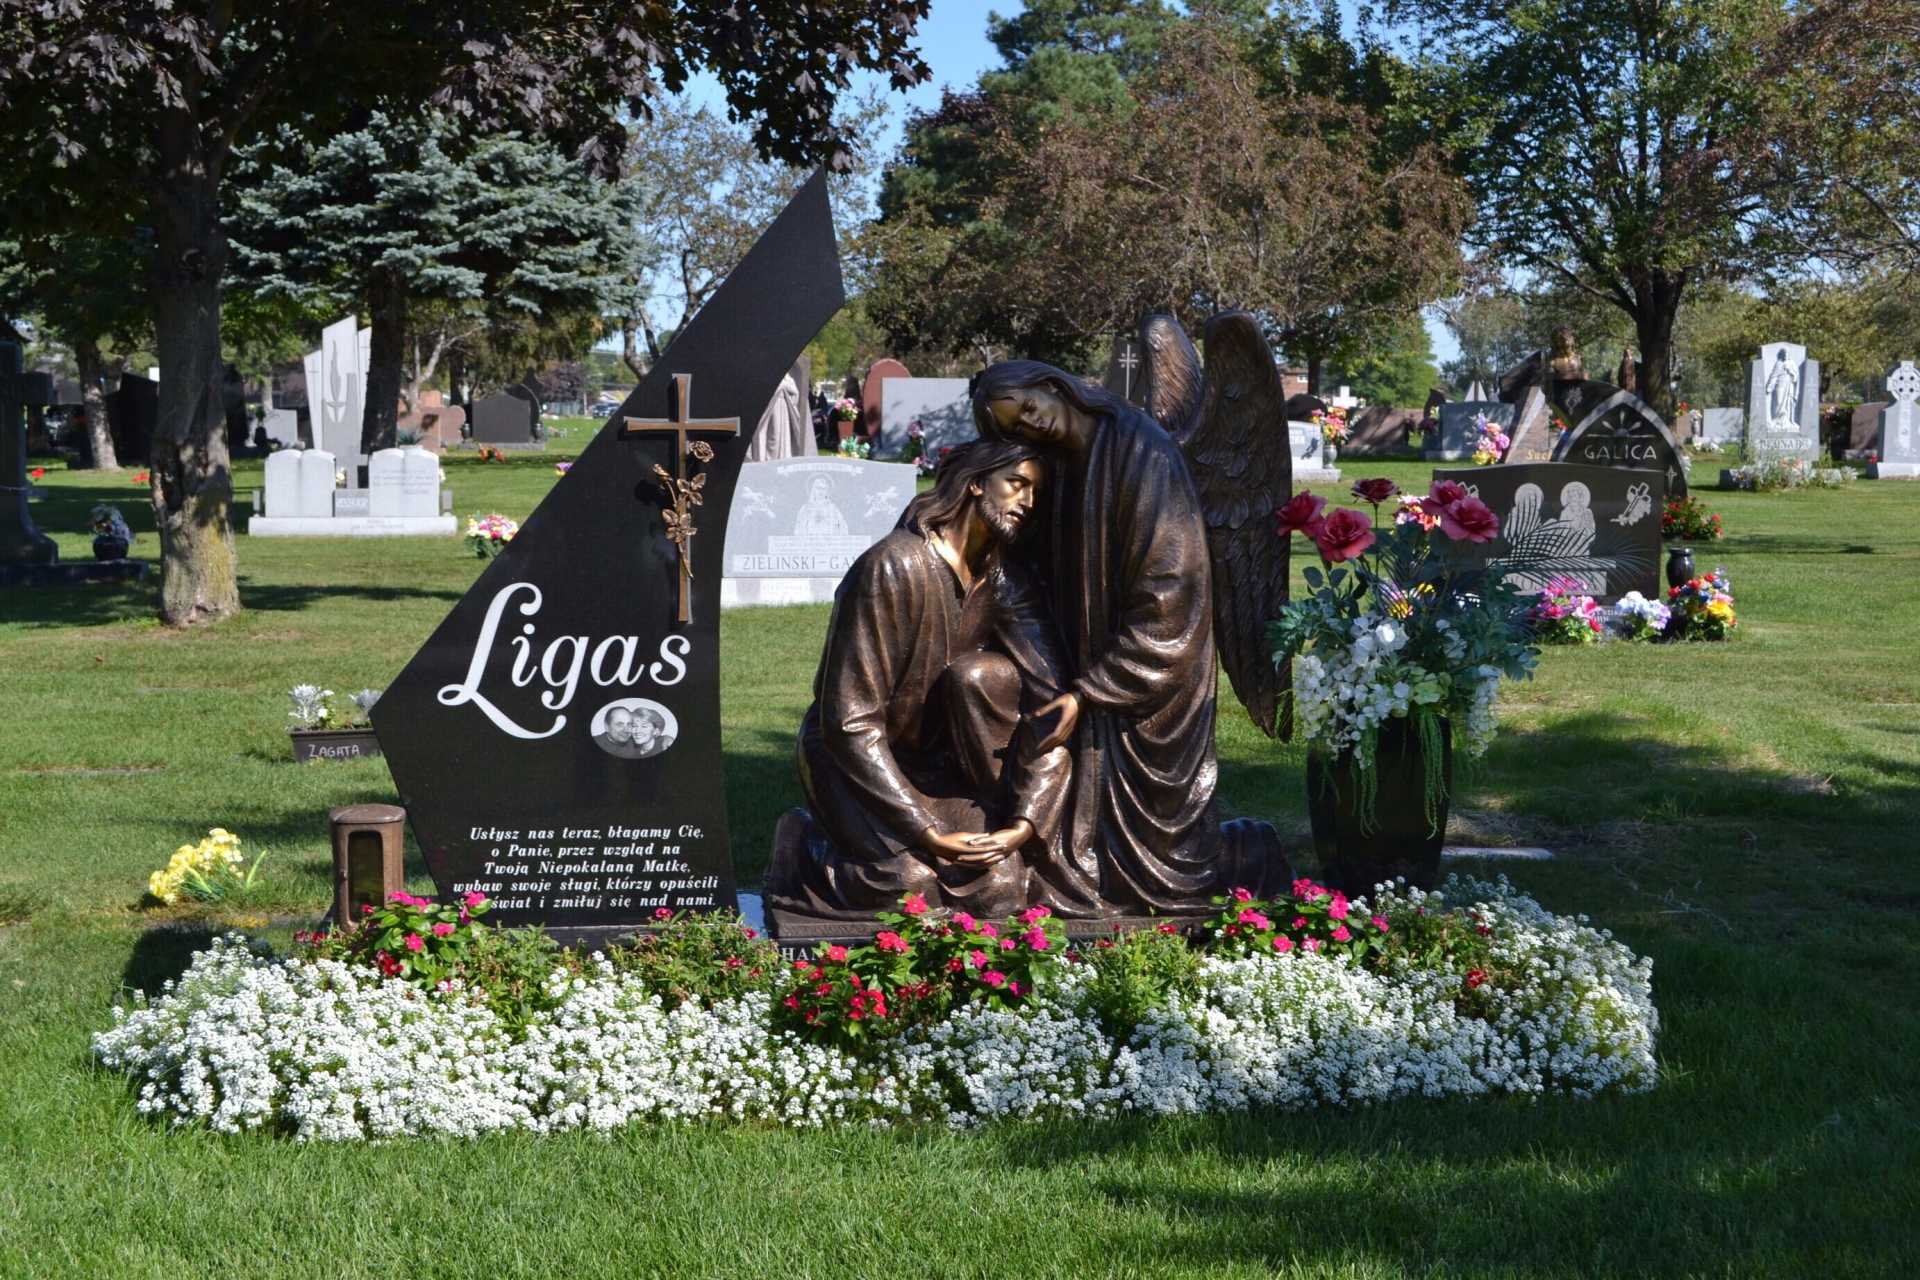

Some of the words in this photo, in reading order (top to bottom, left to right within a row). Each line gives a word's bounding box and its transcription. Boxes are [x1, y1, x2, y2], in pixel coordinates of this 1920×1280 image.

[1584, 444, 1657, 460] GALICA
[436, 581, 691, 739] Ligas
[308, 743, 360, 758] ZAGATA
[470, 827, 520, 841] Usłysz
[528, 830, 555, 839] nas
[608, 825, 671, 840] błagamy
[491, 848, 500, 857] o
[557, 845, 595, 858] przez
[603, 843, 654, 857] wzgląd
[662, 846, 681, 855] na
[484, 862, 529, 875] Twoją
[538, 860, 634, 876] Niepokalaną
[453, 880, 503, 893] wybaw
[510, 879, 551, 893] swoje
[606, 876, 652, 891] którzy
[660, 875, 718, 891] opuścili
[491, 896, 532, 909] świat
[539, 896, 545, 908] i
[553, 894, 602, 909] zmiłuj
[610, 895, 632, 907] się
[640, 894, 668, 907] nad
